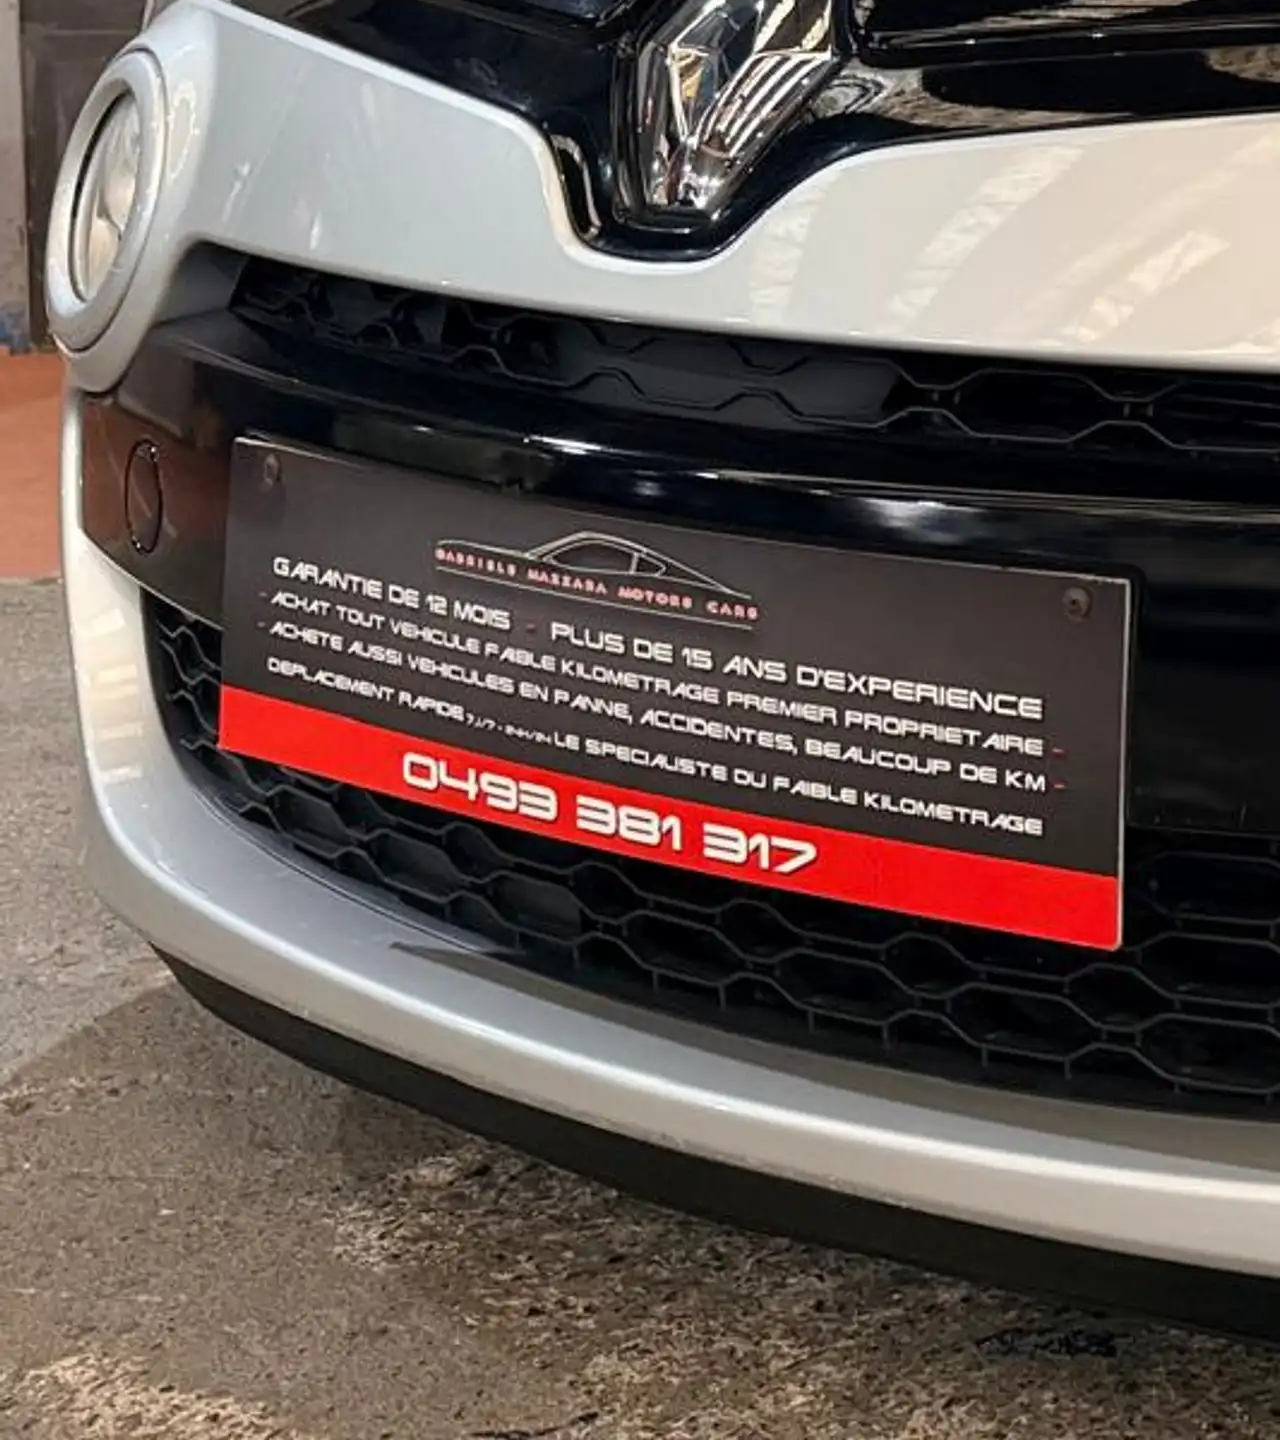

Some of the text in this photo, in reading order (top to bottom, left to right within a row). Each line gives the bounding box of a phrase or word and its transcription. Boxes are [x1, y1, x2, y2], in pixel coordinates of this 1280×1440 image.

[271, 591, 331, 616] ACHAT
[336, 605, 385, 631] TOUT
[389, 617, 480, 655] VEHICULE
[561, 658, 720, 705] KILOMETRAGE
[727, 690, 838, 726] PREMIER
[845, 710, 1044, 757] PROPRIETAIRE
[273, 556, 383, 600] GARANTIE
[389, 584, 420, 609] DE
[425, 593, 448, 616] 12
[454, 600, 511, 630] MOIS
[551, 621, 625, 654] PLUS
[633, 637, 673, 664] DE
[681, 647, 713, 671] 15
[723, 656, 787, 683] ANS
[796, 664, 1043, 720] D'EXPERIENCE
[618, 585, 693, 609] MOTORS
[705, 600, 758, 621] CARS
[267, 656, 394, 703] DEPLACEMENT
[398, 690, 464, 722] RAPIDE
[553, 731, 580, 751] LE
[585, 738, 728, 783] SPECIALISTE
[733, 768, 767, 789] DU
[773, 776, 858, 805] FAIBLE
[864, 791, 1044, 836] KILOMETRAGE
[270, 620, 344, 652] ACHETE
[348, 639, 402, 666] AUSSI
[407, 652, 515, 695] VEHICULES
[519, 680, 549, 702] EN
[554, 688, 632, 725] PANNE,
[640, 709, 798, 756] ACCIDENTES,
[805, 738, 951, 776] BEAUCOUP
[960, 762, 998, 785] DE
[1005, 769, 1046, 793] KM
[402, 751, 817, 875] 0493 381 317
